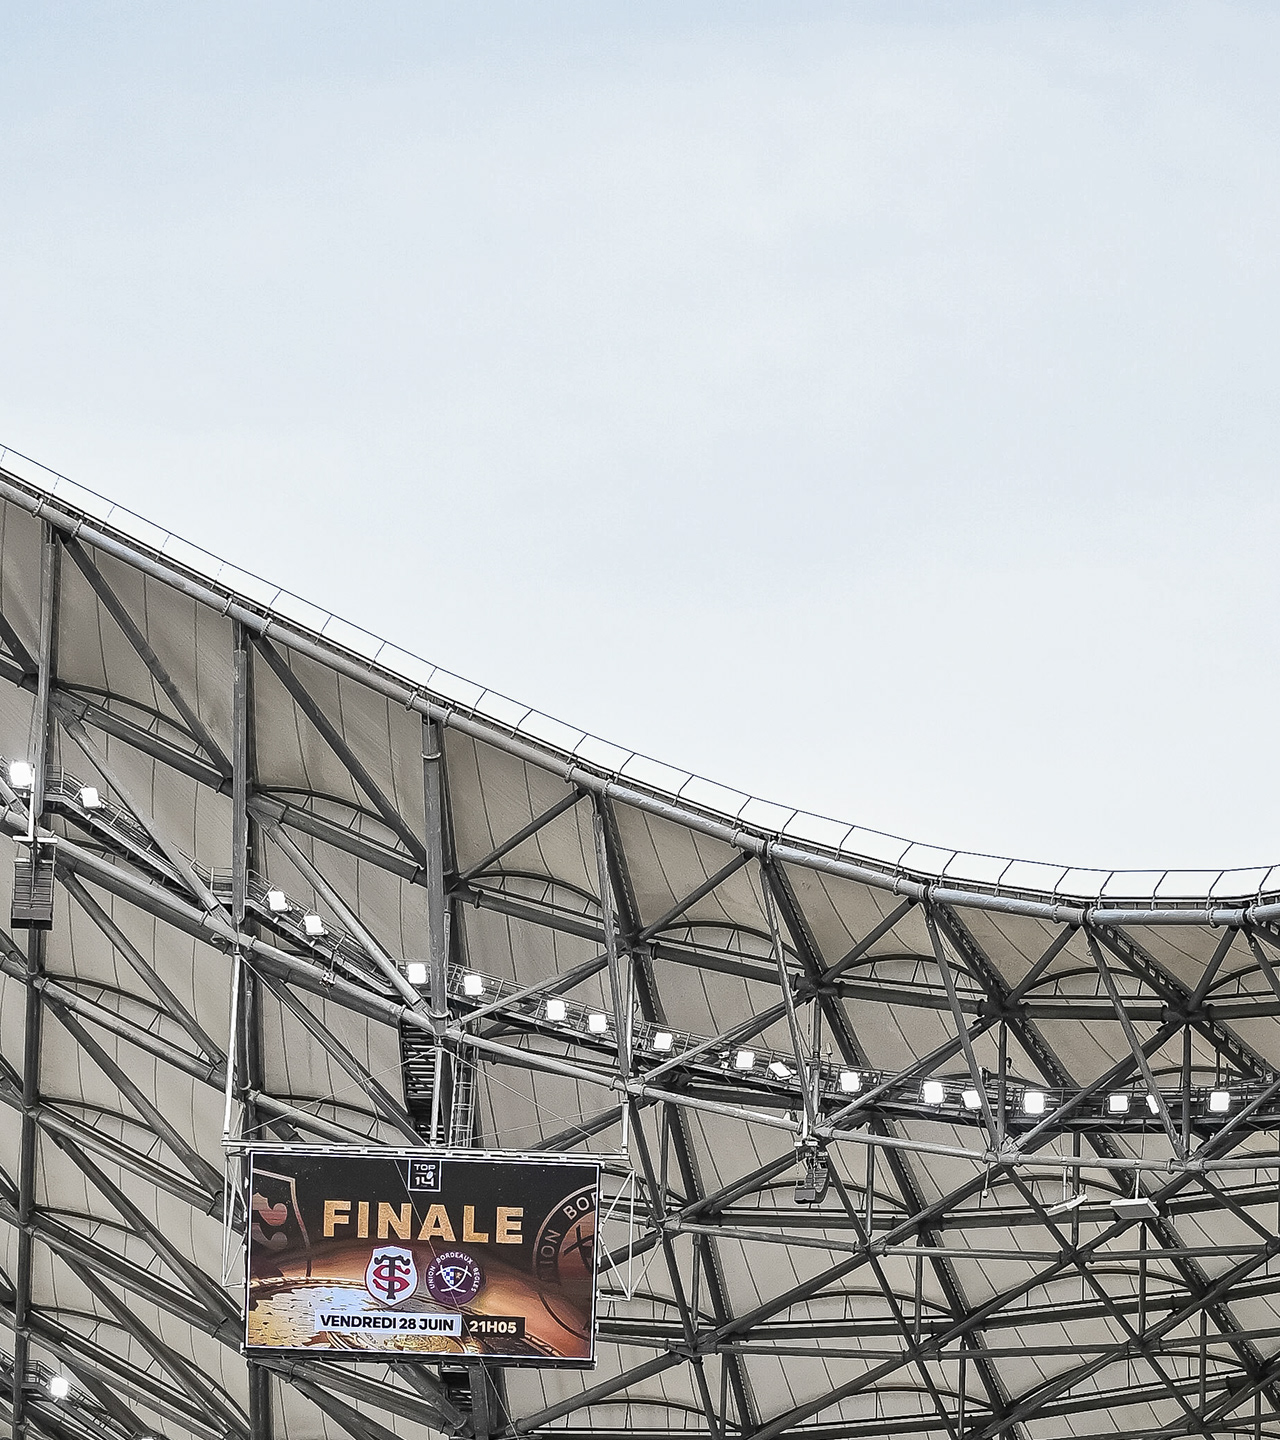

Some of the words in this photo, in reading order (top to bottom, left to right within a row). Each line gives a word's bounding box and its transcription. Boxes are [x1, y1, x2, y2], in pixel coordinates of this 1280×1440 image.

[414, 1163, 436, 1171] TOP
[415, 1176, 435, 1187] 14
[323, 1199, 524, 1245] FINALE
[435, 1251, 474, 1265] BORDEAUX
[428, 1265, 436, 1290] UNION
[320, 1314, 397, 1330] VENDREDI
[399, 1317, 417, 1331] 28
[418, 1318, 455, 1332] JUIN
[469, 1320, 517, 1334] 21H05
